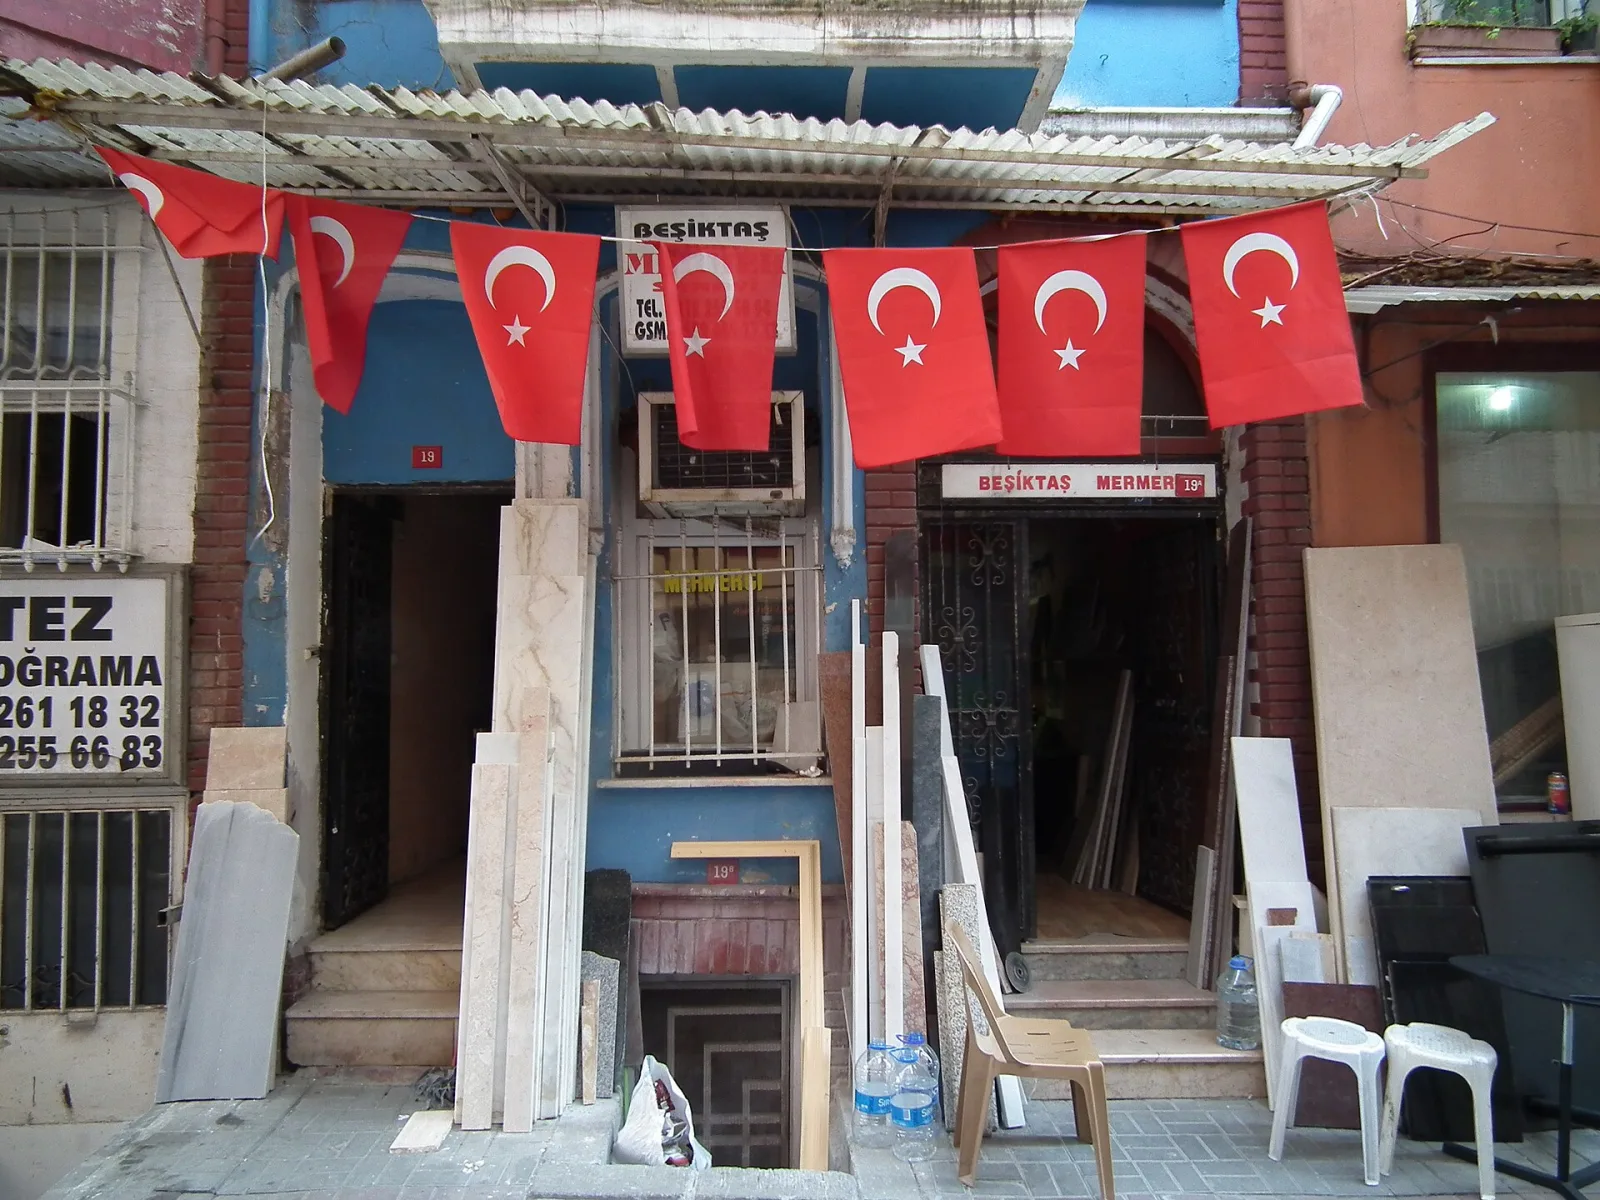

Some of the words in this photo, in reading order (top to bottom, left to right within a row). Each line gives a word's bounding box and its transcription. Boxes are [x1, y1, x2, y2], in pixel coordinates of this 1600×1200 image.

[634, 219, 769, 242] BEŞİKTAŞ
[636, 299, 662, 318] TEL.
[421, 451, 434, 463] 19
[979, 470, 1071, 493] BEŞİKTAŞ
[70, 696, 108, 728] 18
[120, 695, 160, 728] 32
[71, 736, 110, 769] 66
[122, 735, 162, 769] 83
